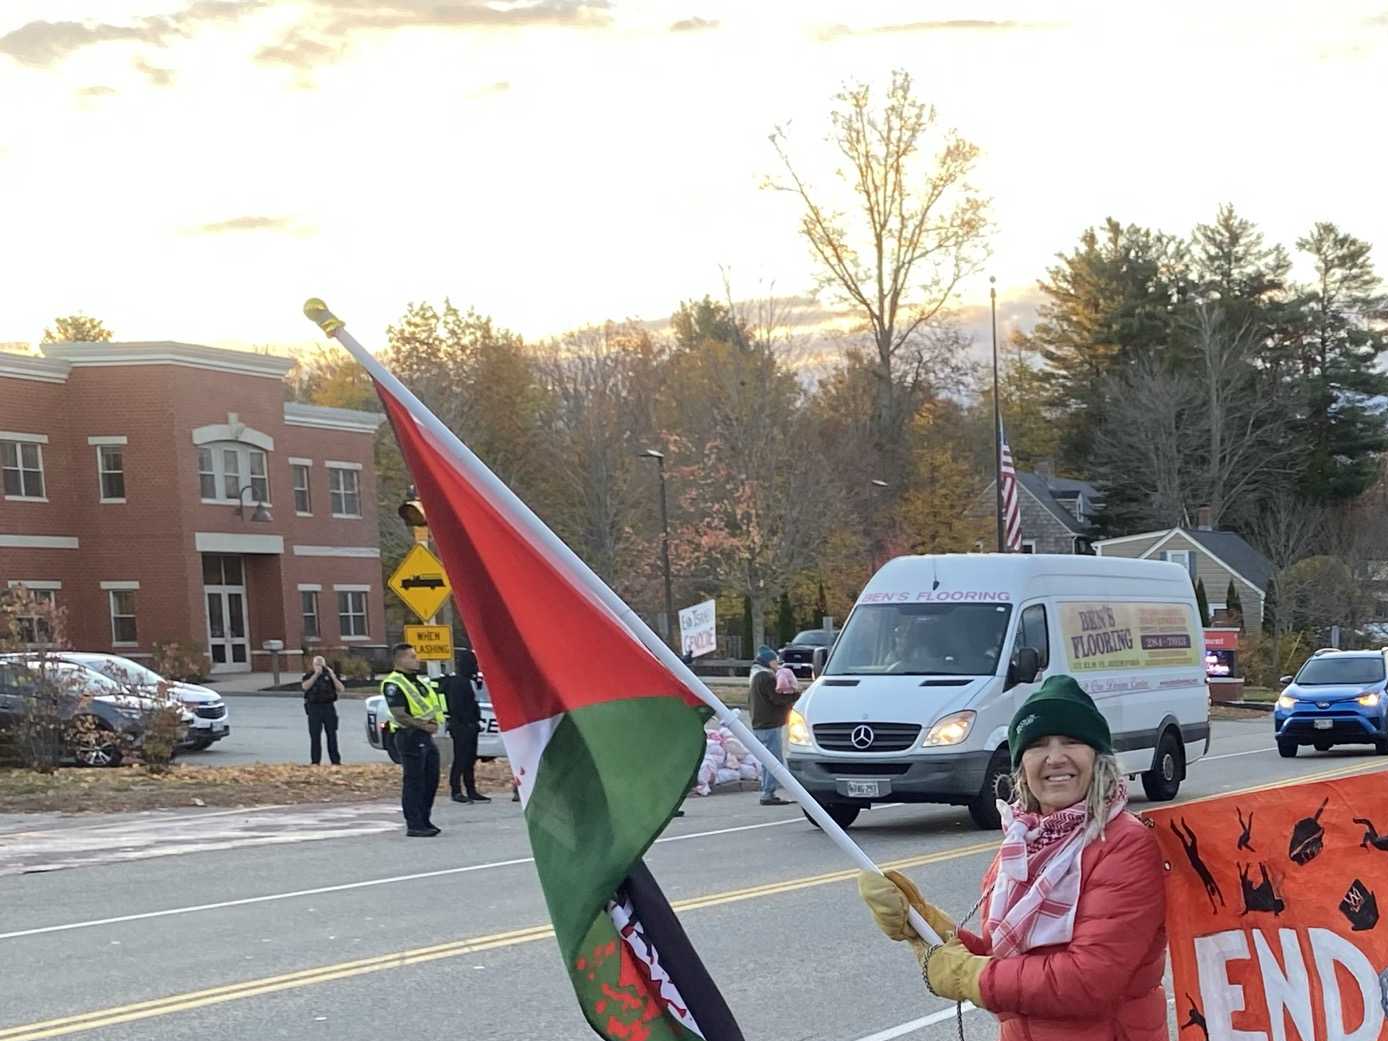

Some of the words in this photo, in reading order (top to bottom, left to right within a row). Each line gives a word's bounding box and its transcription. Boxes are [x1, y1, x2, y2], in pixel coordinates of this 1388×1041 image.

[863, 592, 910, 602] BEN'S
[916, 591, 1011, 601] FLOORING
[1078, 606, 1115, 631] BEN'S
[416, 631, 440, 641] WHEN
[414, 644, 449, 654] LASHING
[1071, 628, 1133, 659] FLOORING
